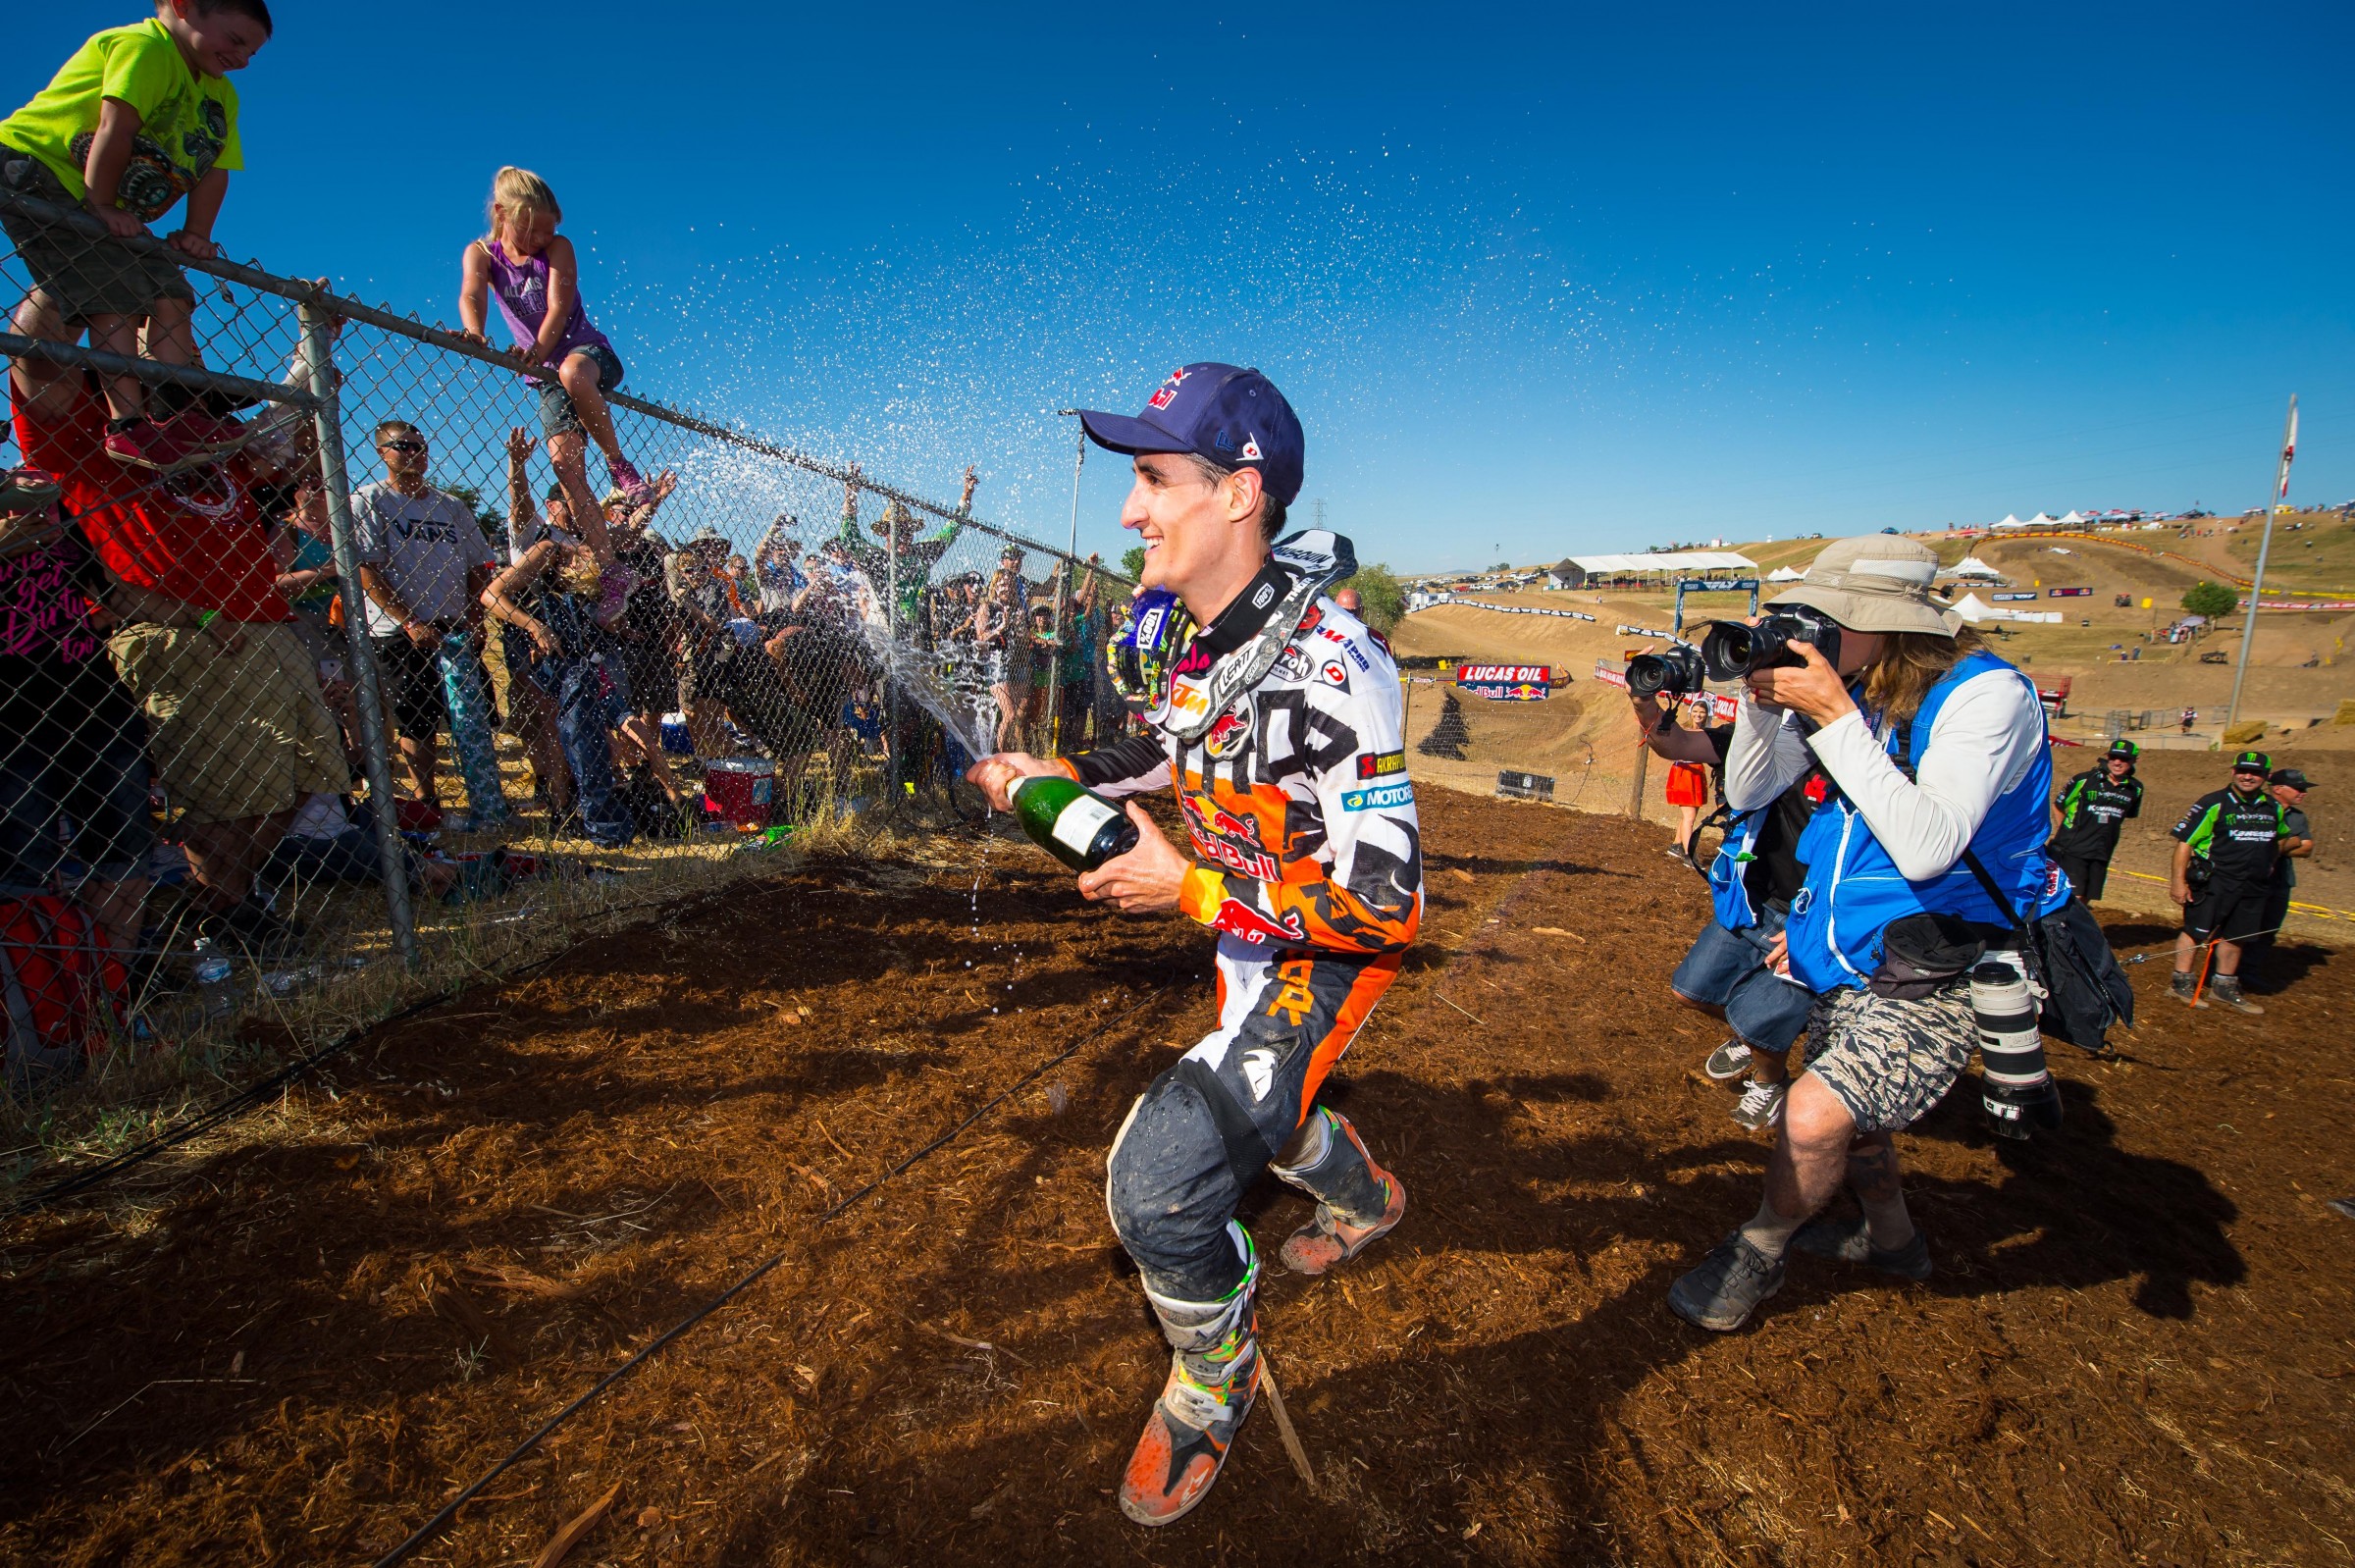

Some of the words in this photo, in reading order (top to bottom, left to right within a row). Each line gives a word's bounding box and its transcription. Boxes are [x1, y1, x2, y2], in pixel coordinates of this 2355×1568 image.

[392, 518, 458, 545] VANS
[1256, 587, 1273, 606] 100%
[1139, 612, 1159, 645] 100%
[1222, 646, 1254, 686] LEATT
[1280, 653, 1309, 677] roh
[1464, 666, 1514, 681] LUCAS
[1516, 667, 1542, 681] OIL
[1481, 685, 1504, 699] Bull
[1366, 784, 1413, 806] MOTORE
[1219, 839, 1281, 883] Bull
